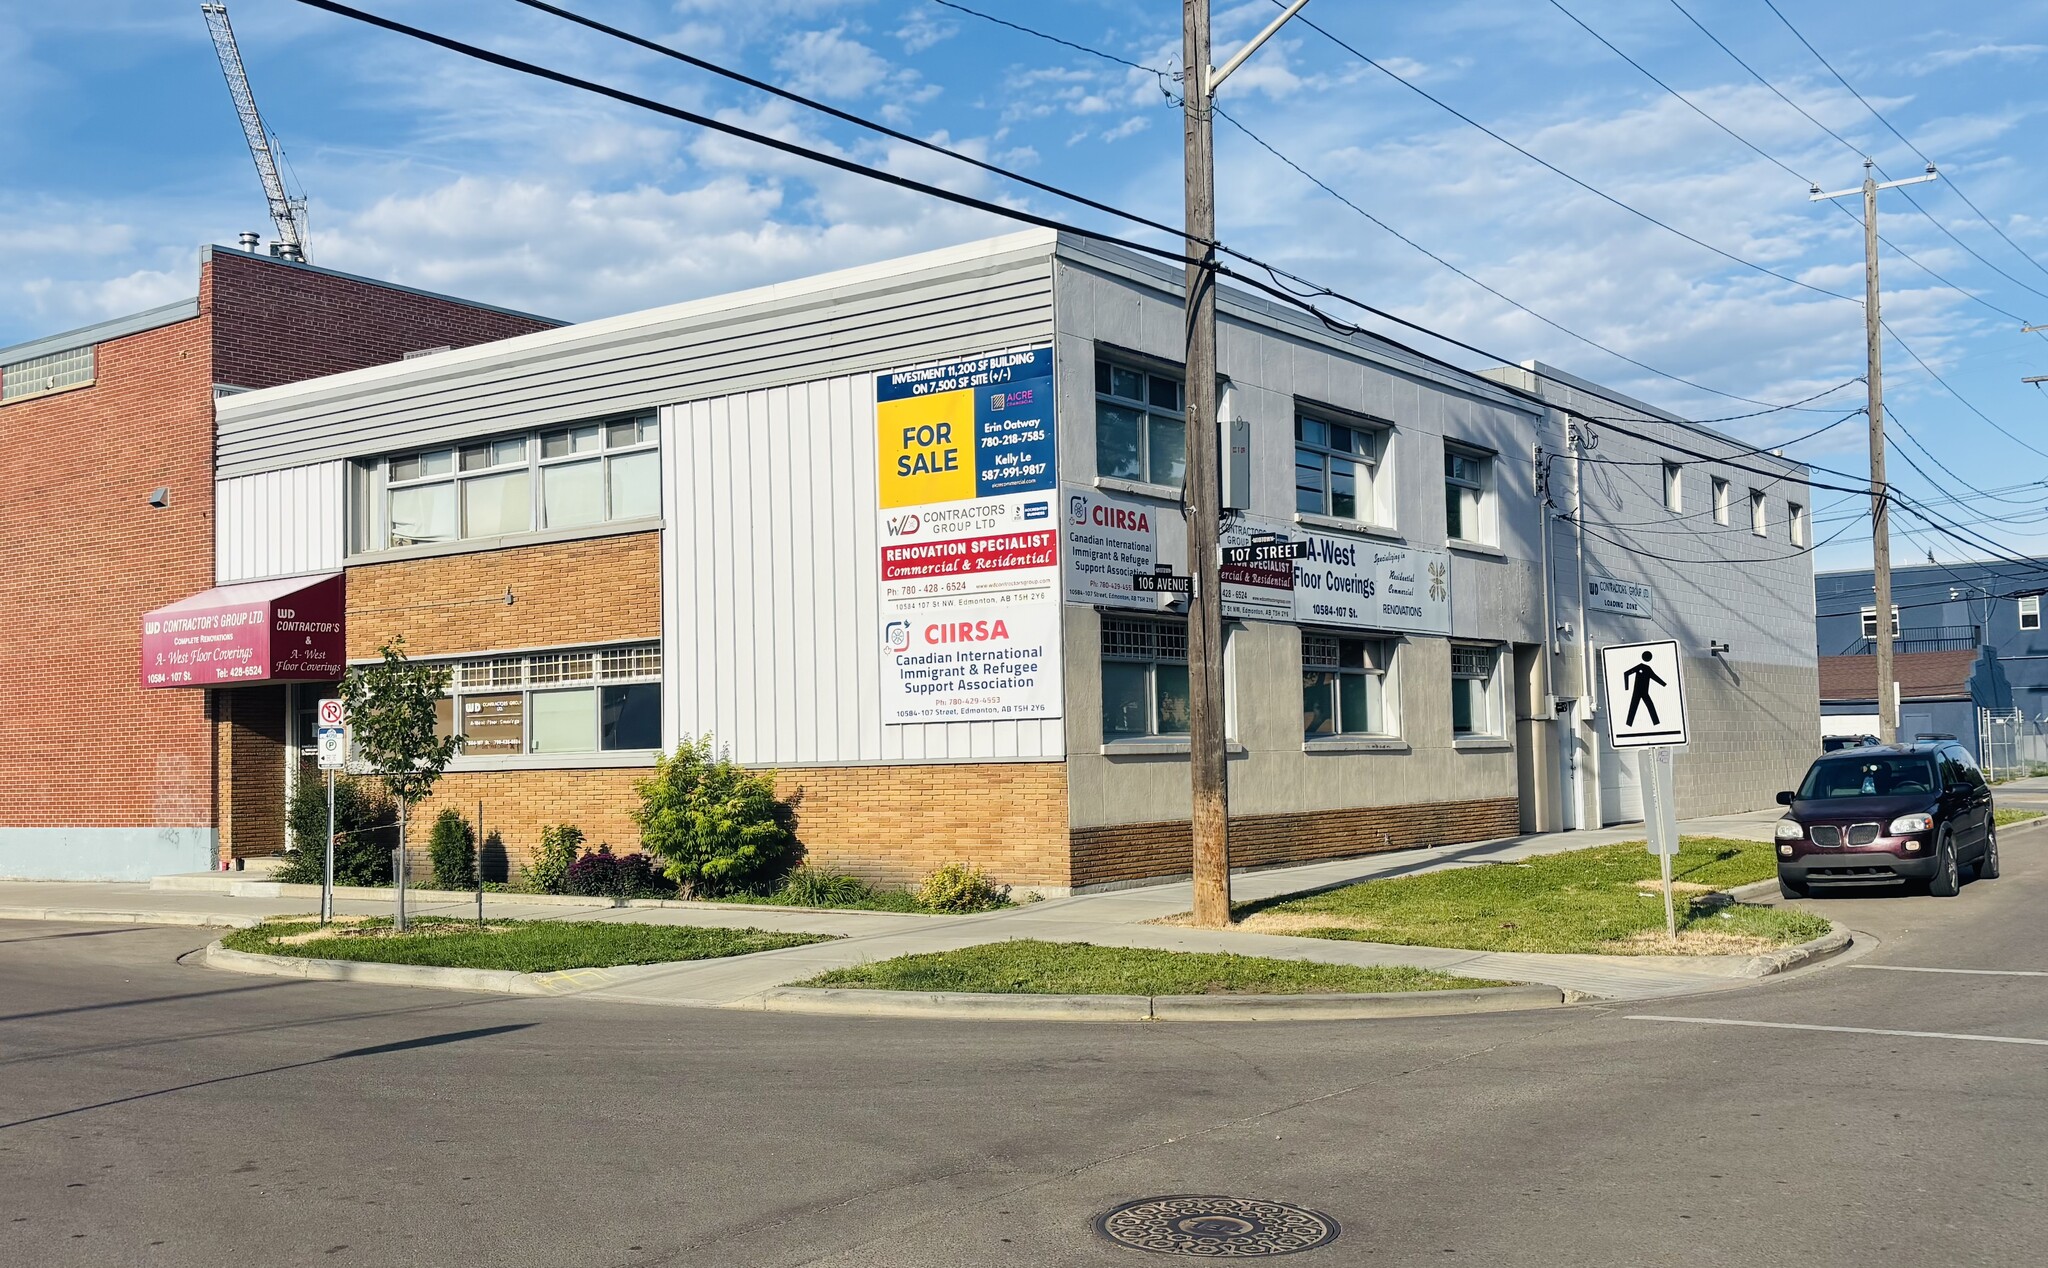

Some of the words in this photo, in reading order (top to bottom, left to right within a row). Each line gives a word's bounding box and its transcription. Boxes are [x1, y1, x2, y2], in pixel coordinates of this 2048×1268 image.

[892, 367, 946, 385] INVESTMENT
[948, 362, 976, 377] 11,200
[978, 359, 989, 371] SF
[990, 352, 1035, 369] BUILDING
[912, 383, 928, 395] ON
[929, 379, 956, 394] 7,500
[958, 376, 969, 388] SF
[970, 372, 988, 386] SITE
[989, 367, 1011, 384] (+/-)
[1006, 390, 1033, 402] AICRE
[984, 422, 1002, 433] Erin
[1004, 418, 1040, 430] Oatway
[903, 422, 952, 450] FOR
[981, 430, 1045, 448] 780-218-7585
[897, 448, 958, 477] SALE
[995, 453, 1018, 466] Kelly
[1020, 452, 1032, 462] Le
[981, 463, 1047, 481] 587-991-9817
[924, 504, 1006, 523] CONTRACTORS
[1092, 505, 1150, 533] CIIRSA
[933, 521, 971, 534] GROUP
[975, 518, 996, 530] LTD
[887, 542, 966, 562] RENOVATION
[971, 534, 1050, 554] SPECIALIST
[1070, 532, 1104, 546] Canadian
[1106, 538, 1152, 552] International
[1227, 536, 1250, 546] GROUP
[1072, 546, 1112, 561] Immigrant
[1112, 552, 1118, 560] &
[1120, 553, 1150, 566] Refugee
[1230, 548, 1250, 562] 107
[1256, 544, 1298, 560] STREET
[1307, 537, 1356, 567] A-West
[887, 558, 960, 578] Commercial
[962, 560, 971, 570] &
[976, 550, 1052, 570] Residential
[1076, 560, 1105, 574] Support
[1138, 577, 1154, 590] 106
[1157, 578, 1188, 591] AVENUE
[1221, 570, 1244, 581] ercial
[1244, 572, 1250, 582] &
[1252, 574, 1291, 588] Residential
[1294, 566, 1322, 590] Floor
[1326, 570, 1375, 598] Coverings
[1389, 570, 1415, 582] Residential
[902, 586, 916, 596] 780
[924, 584, 938, 593] 428
[946, 582, 966, 592] 6524
[1100, 582, 1133, 592] 780-429-455
[1236, 590, 1248, 598] 6524
[1388, 584, 1414, 596] Commercial
[1589, 582, 1598, 596] WD
[1031, 592, 1045, 600] 2Y6
[278, 608, 296, 618] WD
[1312, 604, 1346, 618] 10584-107
[1348, 608, 1358, 618] St.
[1382, 604, 1422, 618] RENOVATIONS
[1604, 600, 1624, 608] LOADING
[1626, 602, 1638, 610] ZONE
[145, 621, 160, 635] WD
[163, 614, 218, 634] CONTRACTOR'S
[221, 612, 248, 628] GROUP
[248, 610, 264, 624] LTD.
[276, 621, 340, 632] CONTRACTOR'S
[305, 636, 312, 644] &
[924, 619, 1010, 645] CIIRSA
[168, 649, 188, 664] West
[190, 647, 211, 665] Floor
[213, 646, 253, 664] Coverings
[304, 648, 326, 659] West
[896, 652, 952, 666] Canadian
[956, 646, 1043, 662] International
[148, 673, 166, 684] 10584
[171, 672, 182, 682] 107
[184, 671, 192, 681] St.
[216, 668, 228, 678] Tel:
[230, 665, 262, 676] 428-6524
[275, 660, 299, 672] Floor
[300, 662, 341, 676] Coverings
[900, 665, 966, 680] Immigrant
[970, 664, 979, 675] &
[984, 662, 1038, 676] Refugee
[904, 681, 954, 695] Support
[958, 676, 1034, 691] Association
[1030, 704, 1046, 712] 2Y6
